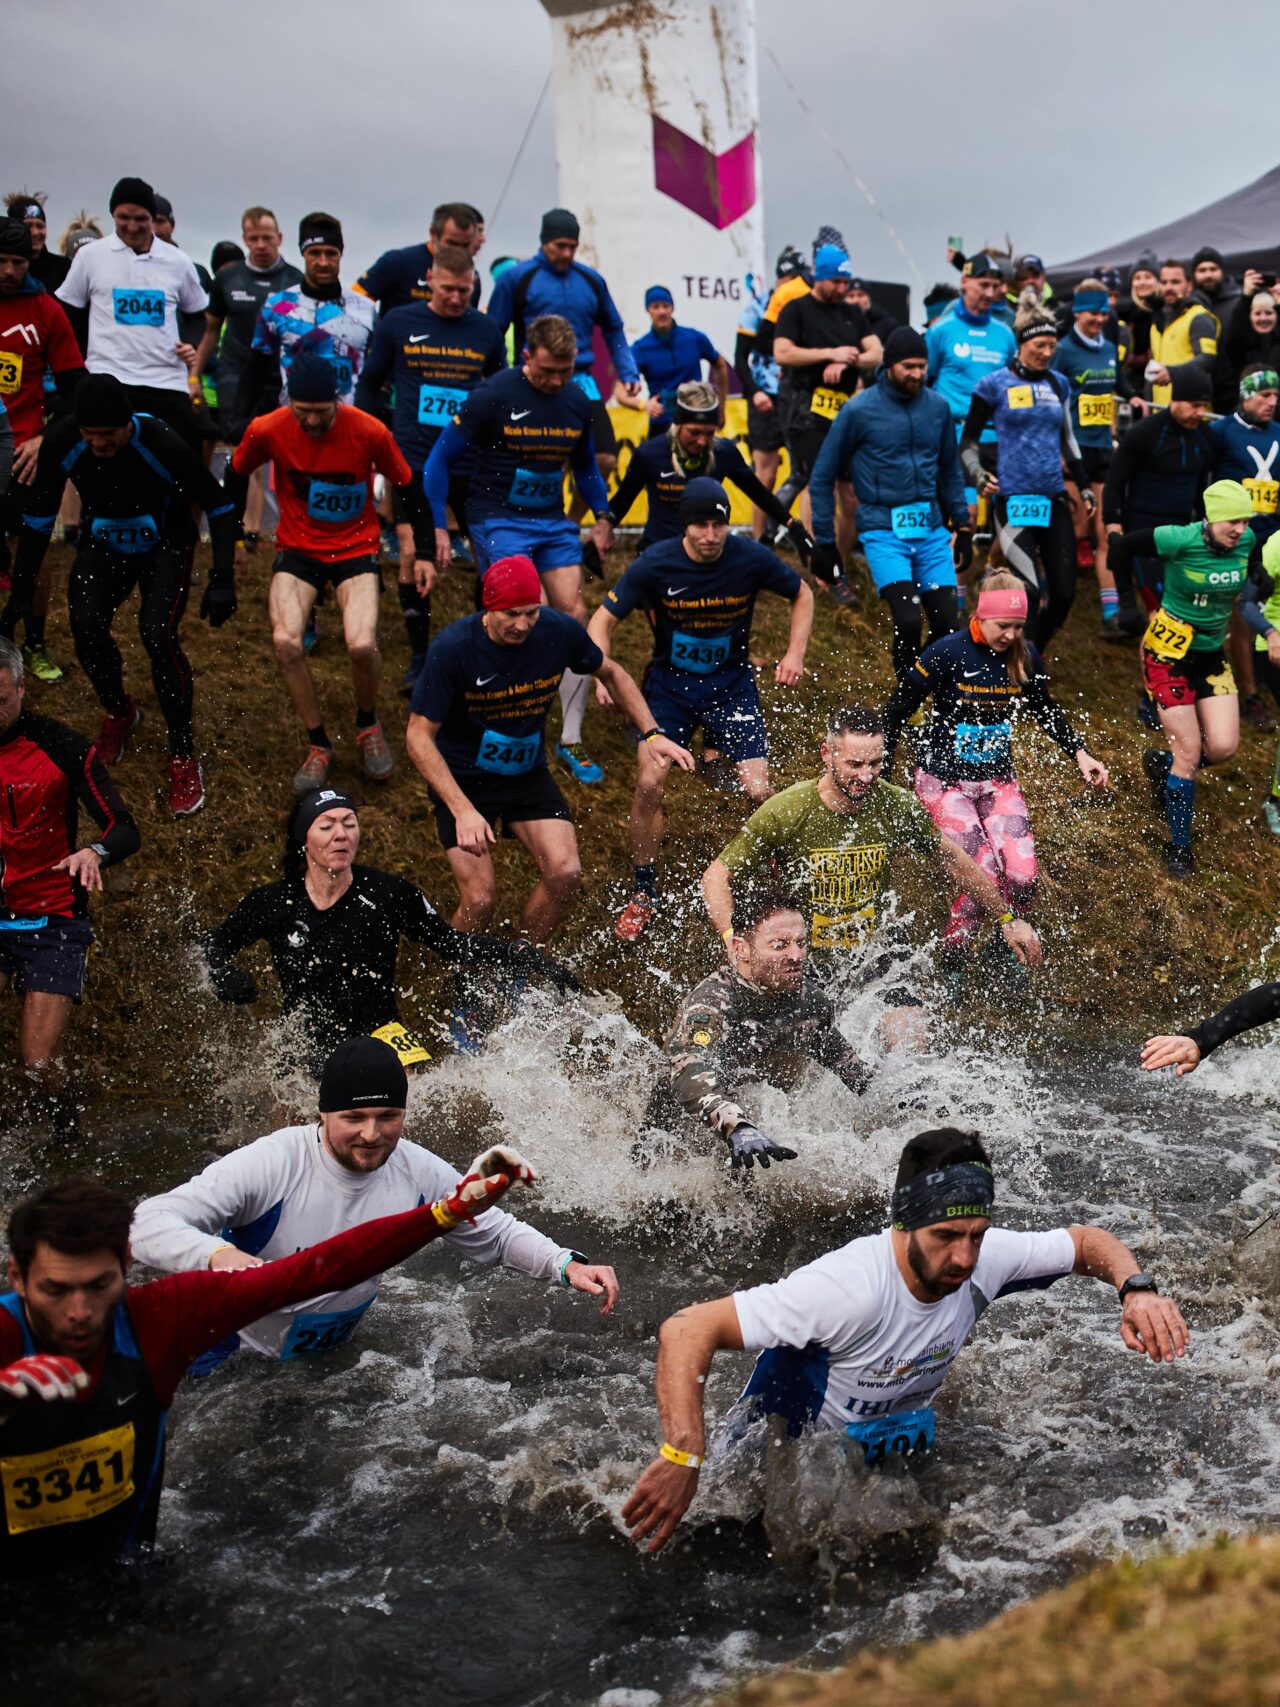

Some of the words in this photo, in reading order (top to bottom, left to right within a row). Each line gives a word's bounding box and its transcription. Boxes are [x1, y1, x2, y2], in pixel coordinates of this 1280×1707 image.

[683, 275, 741, 301] TEAG
[116, 298, 163, 315] 2044
[312, 492, 362, 512] 2031
[1010, 503, 1049, 519] 2297
[1208, 570, 1240, 585] OCR
[1150, 618, 1187, 651] 3272
[674, 643, 726, 664] 2439
[483, 743, 535, 764] 2441
[13, 1449, 124, 1510] 3341
